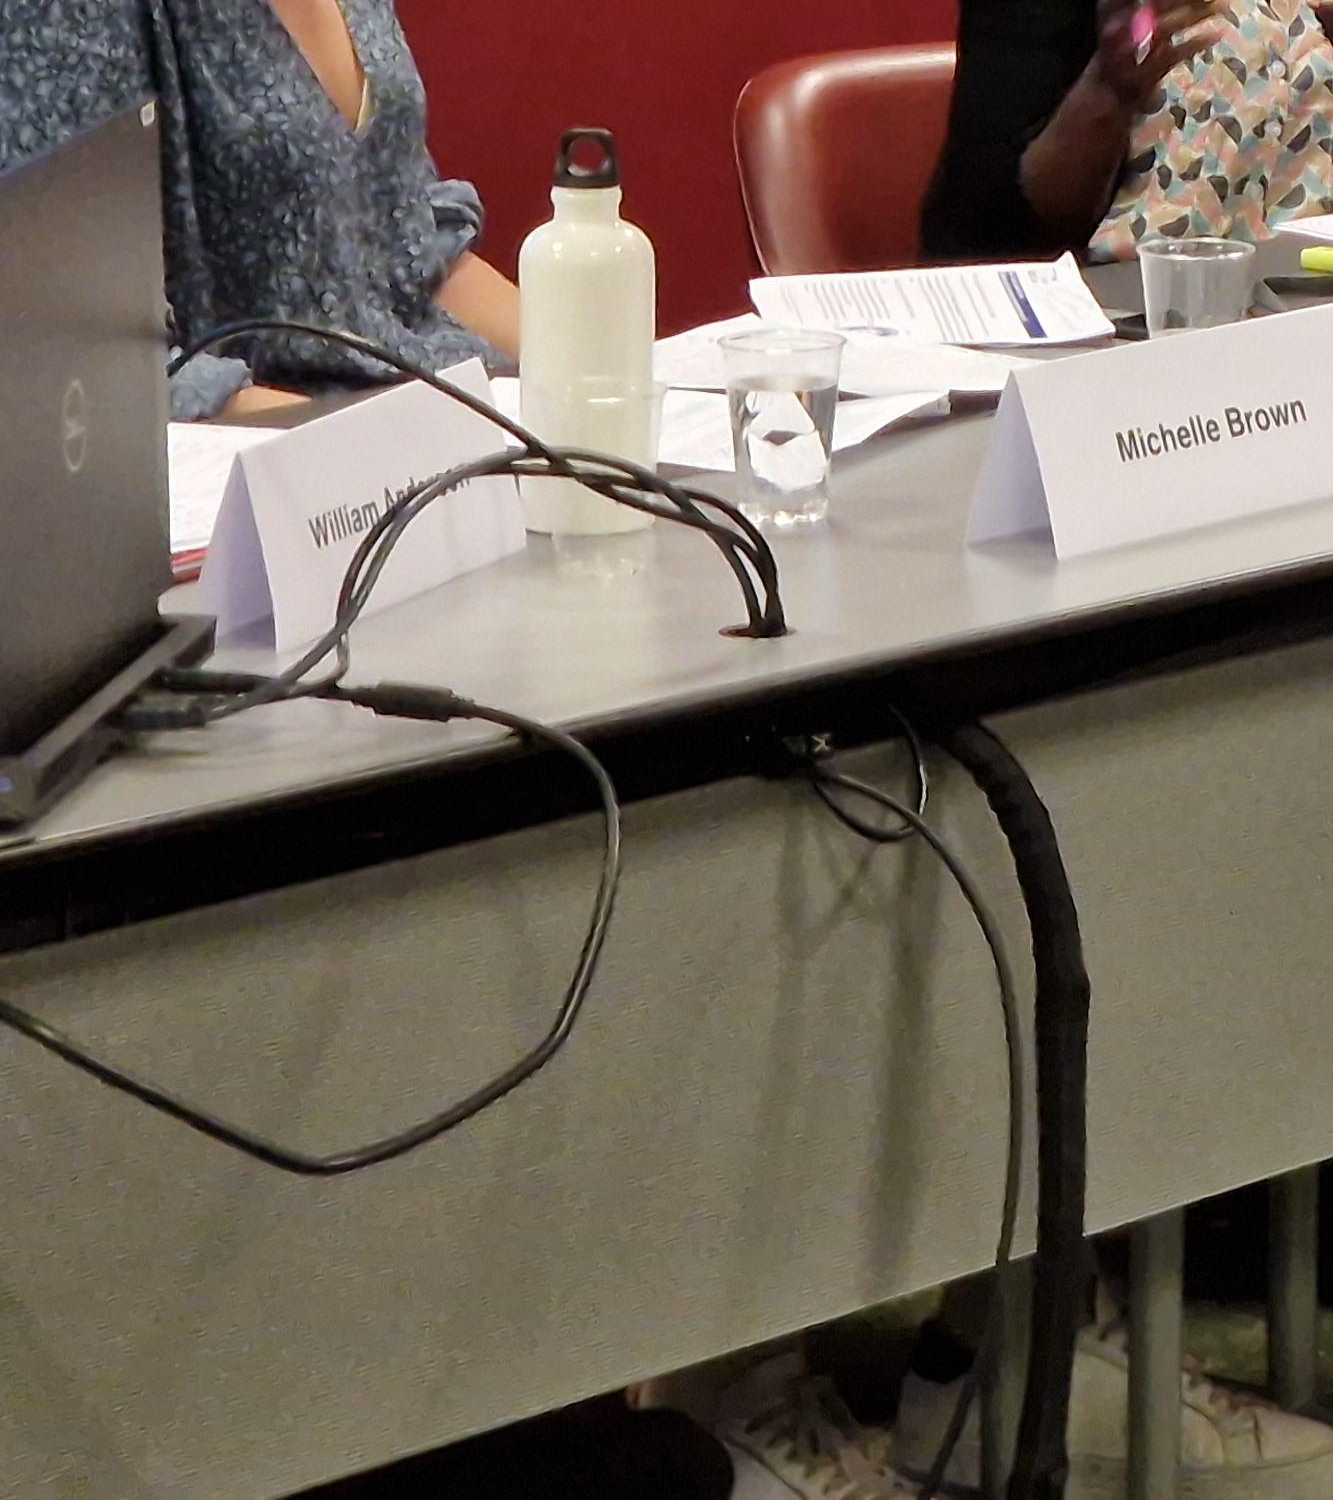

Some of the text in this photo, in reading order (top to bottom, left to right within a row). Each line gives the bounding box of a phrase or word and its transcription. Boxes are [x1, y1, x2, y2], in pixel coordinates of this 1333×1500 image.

[1115, 399, 1308, 463] Michelle Brown
[308, 500, 381, 549] William
